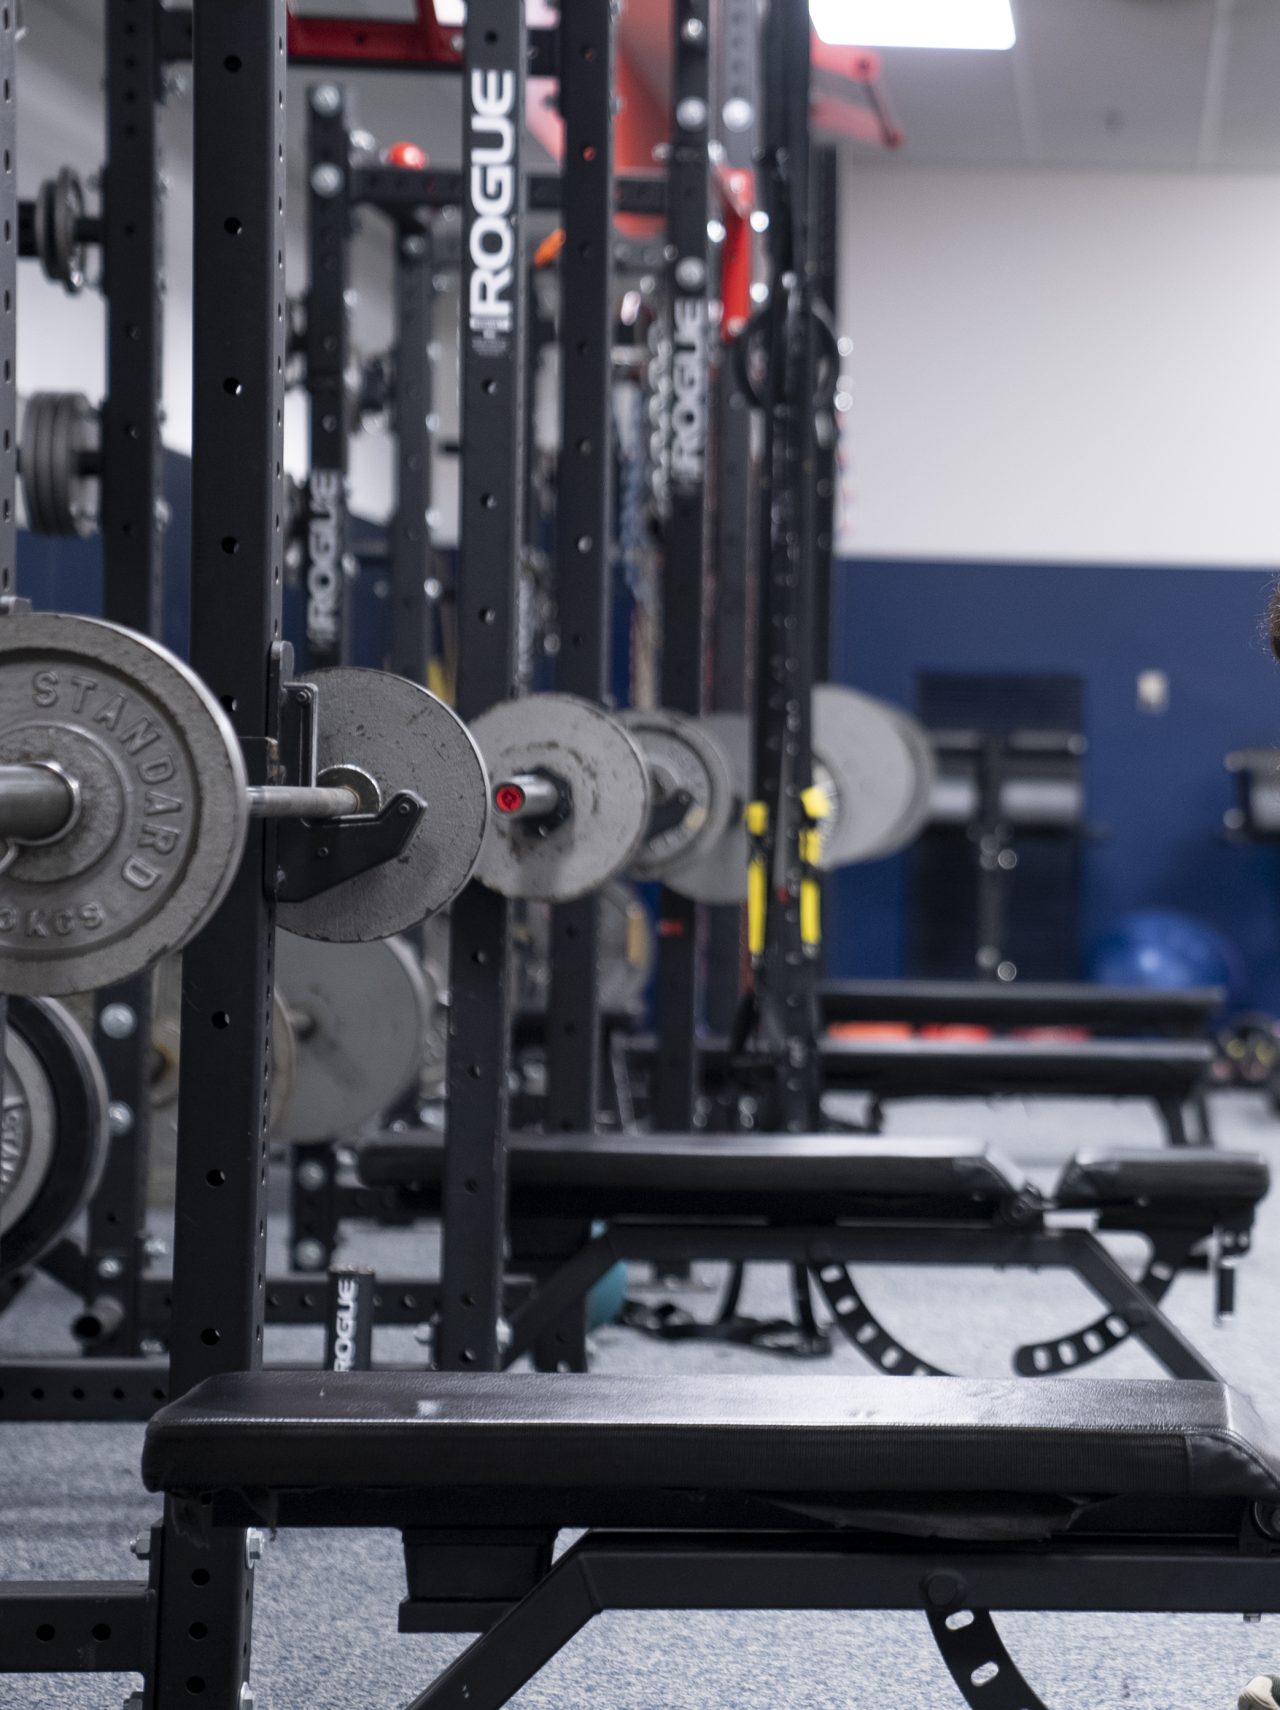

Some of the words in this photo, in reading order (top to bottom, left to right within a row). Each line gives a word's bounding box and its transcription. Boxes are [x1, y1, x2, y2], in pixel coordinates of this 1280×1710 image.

[469, 68, 514, 317] ROGUE
[670, 299, 706, 471] ROGUE
[307, 470, 339, 630] ROGUE
[31, 670, 182, 891] STANDARD
[334, 1278, 358, 1372] ROGUE
